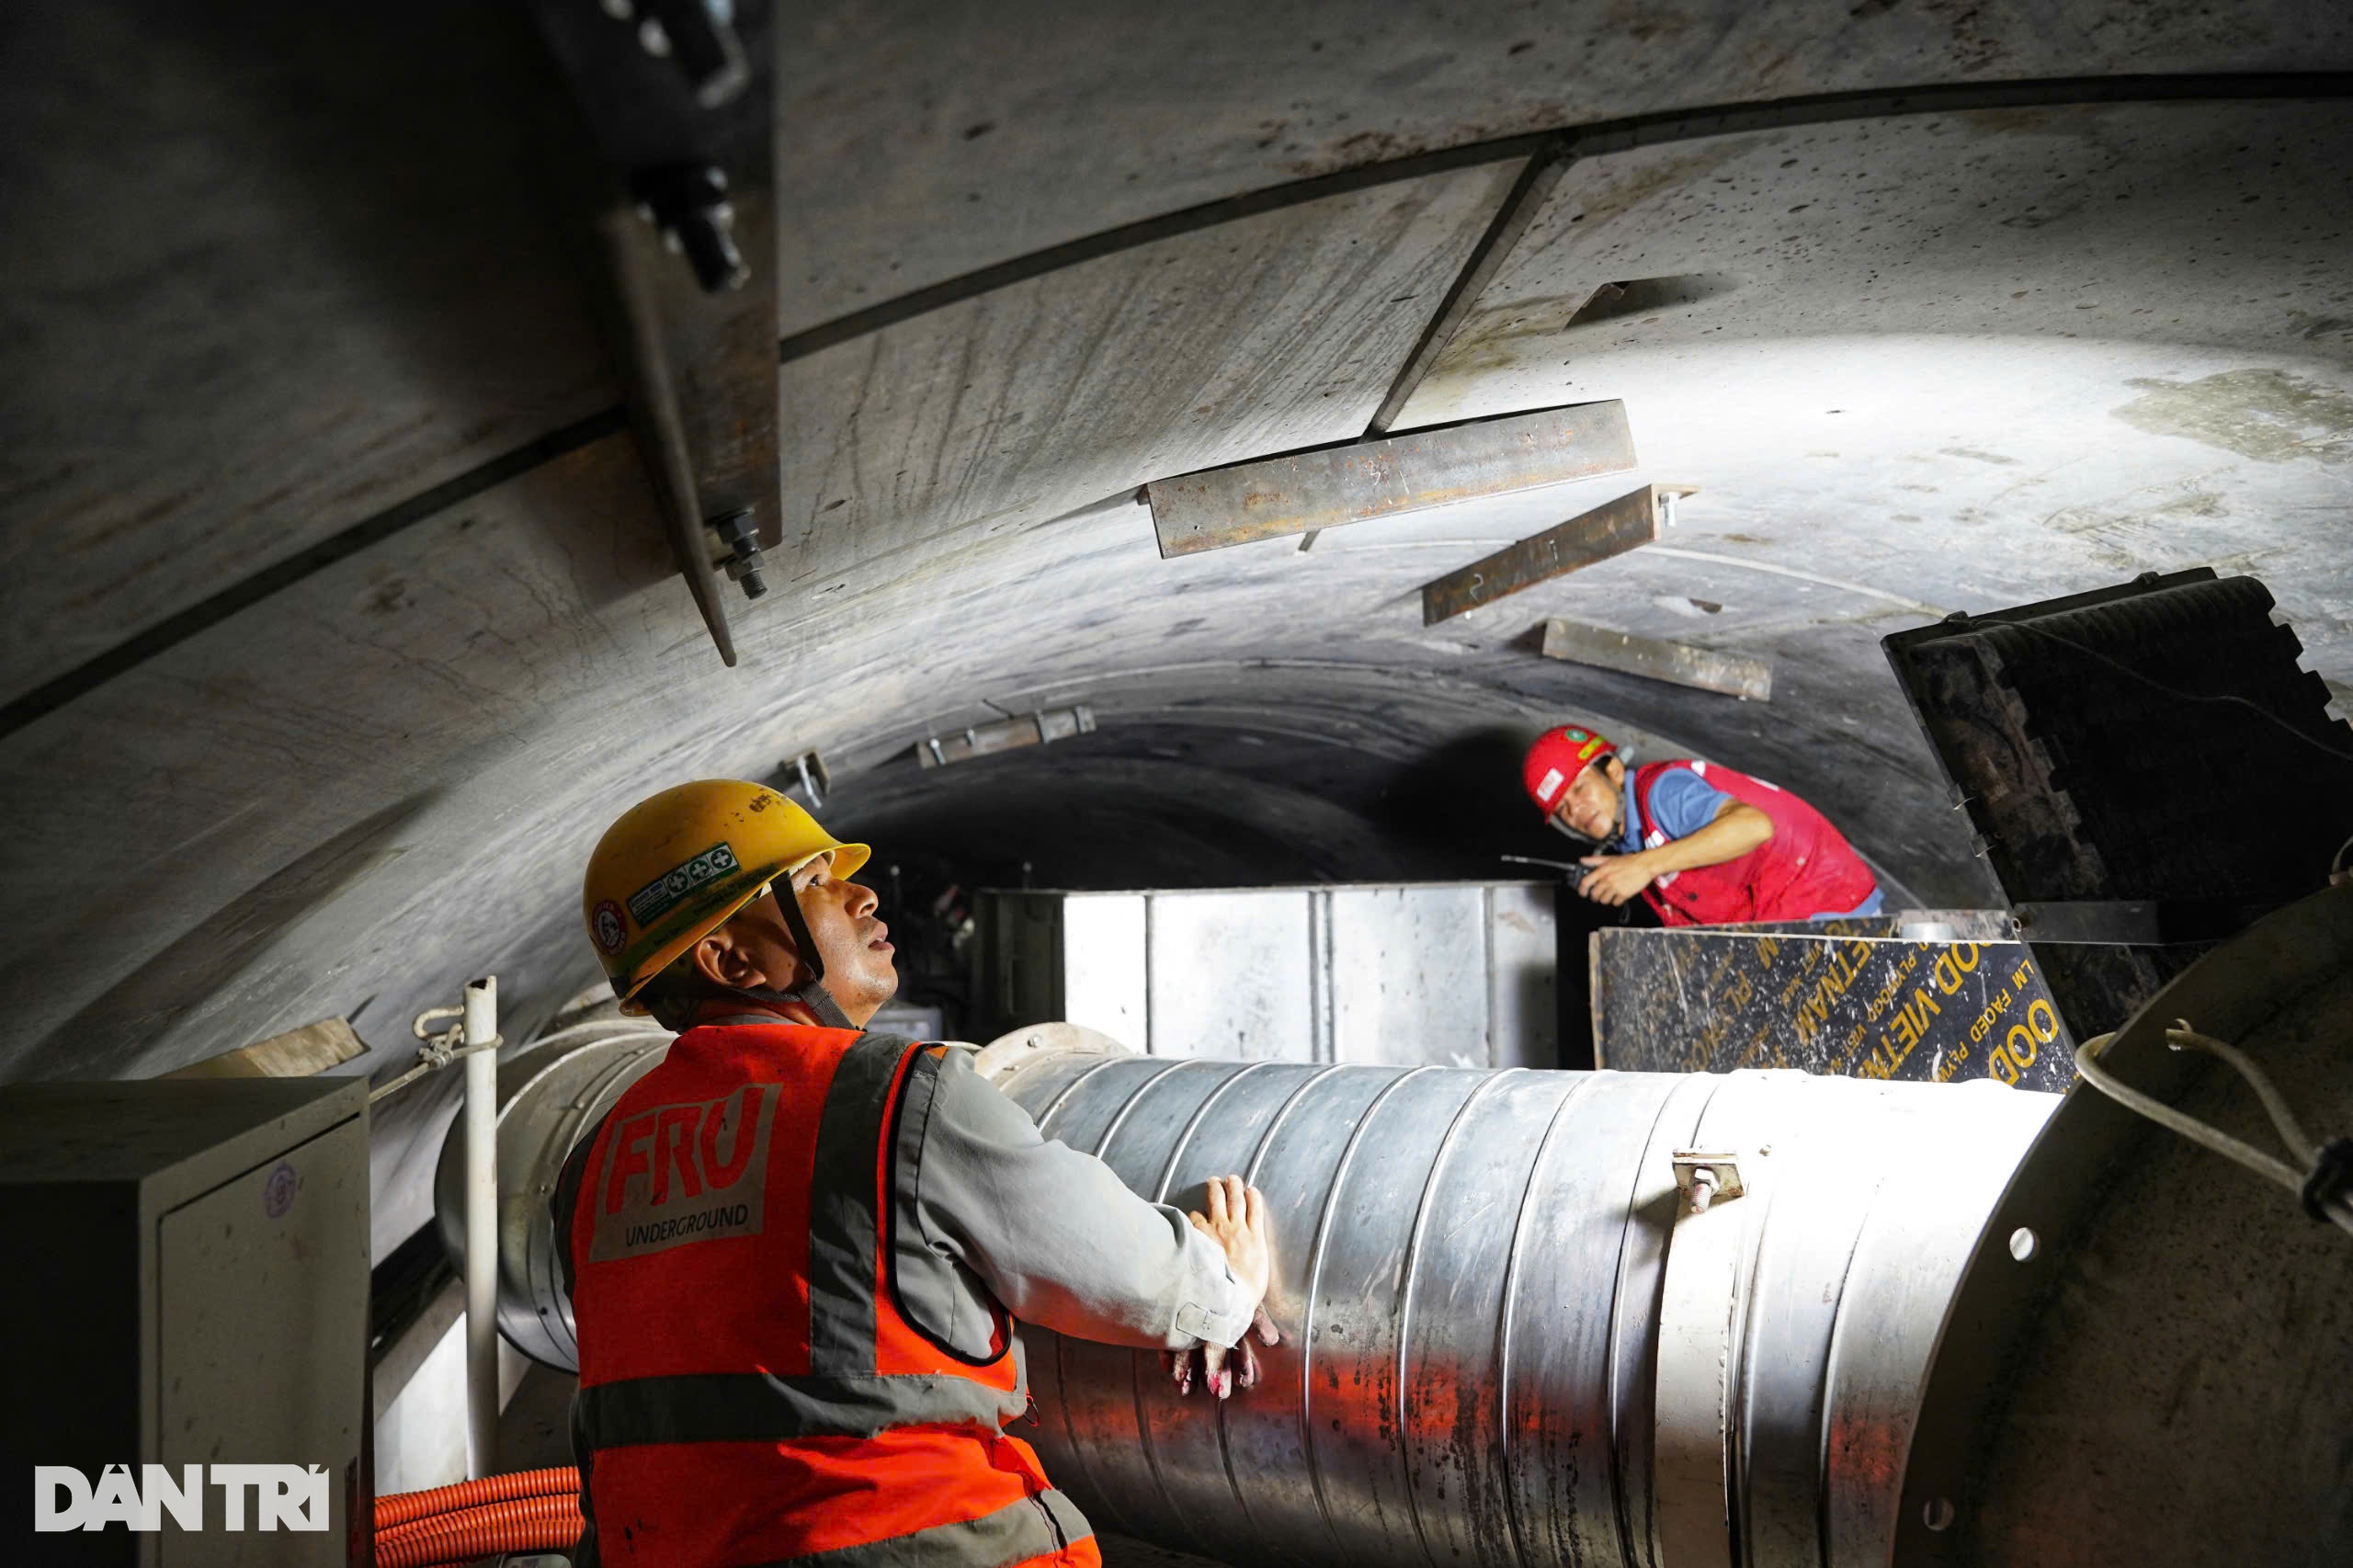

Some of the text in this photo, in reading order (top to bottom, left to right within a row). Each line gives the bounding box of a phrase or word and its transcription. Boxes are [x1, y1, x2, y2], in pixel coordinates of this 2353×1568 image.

[1971, 988, 2011, 1042] FACED
[606, 1087, 766, 1215] FRU
[626, 1205, 748, 1246] UNDERGROUND
